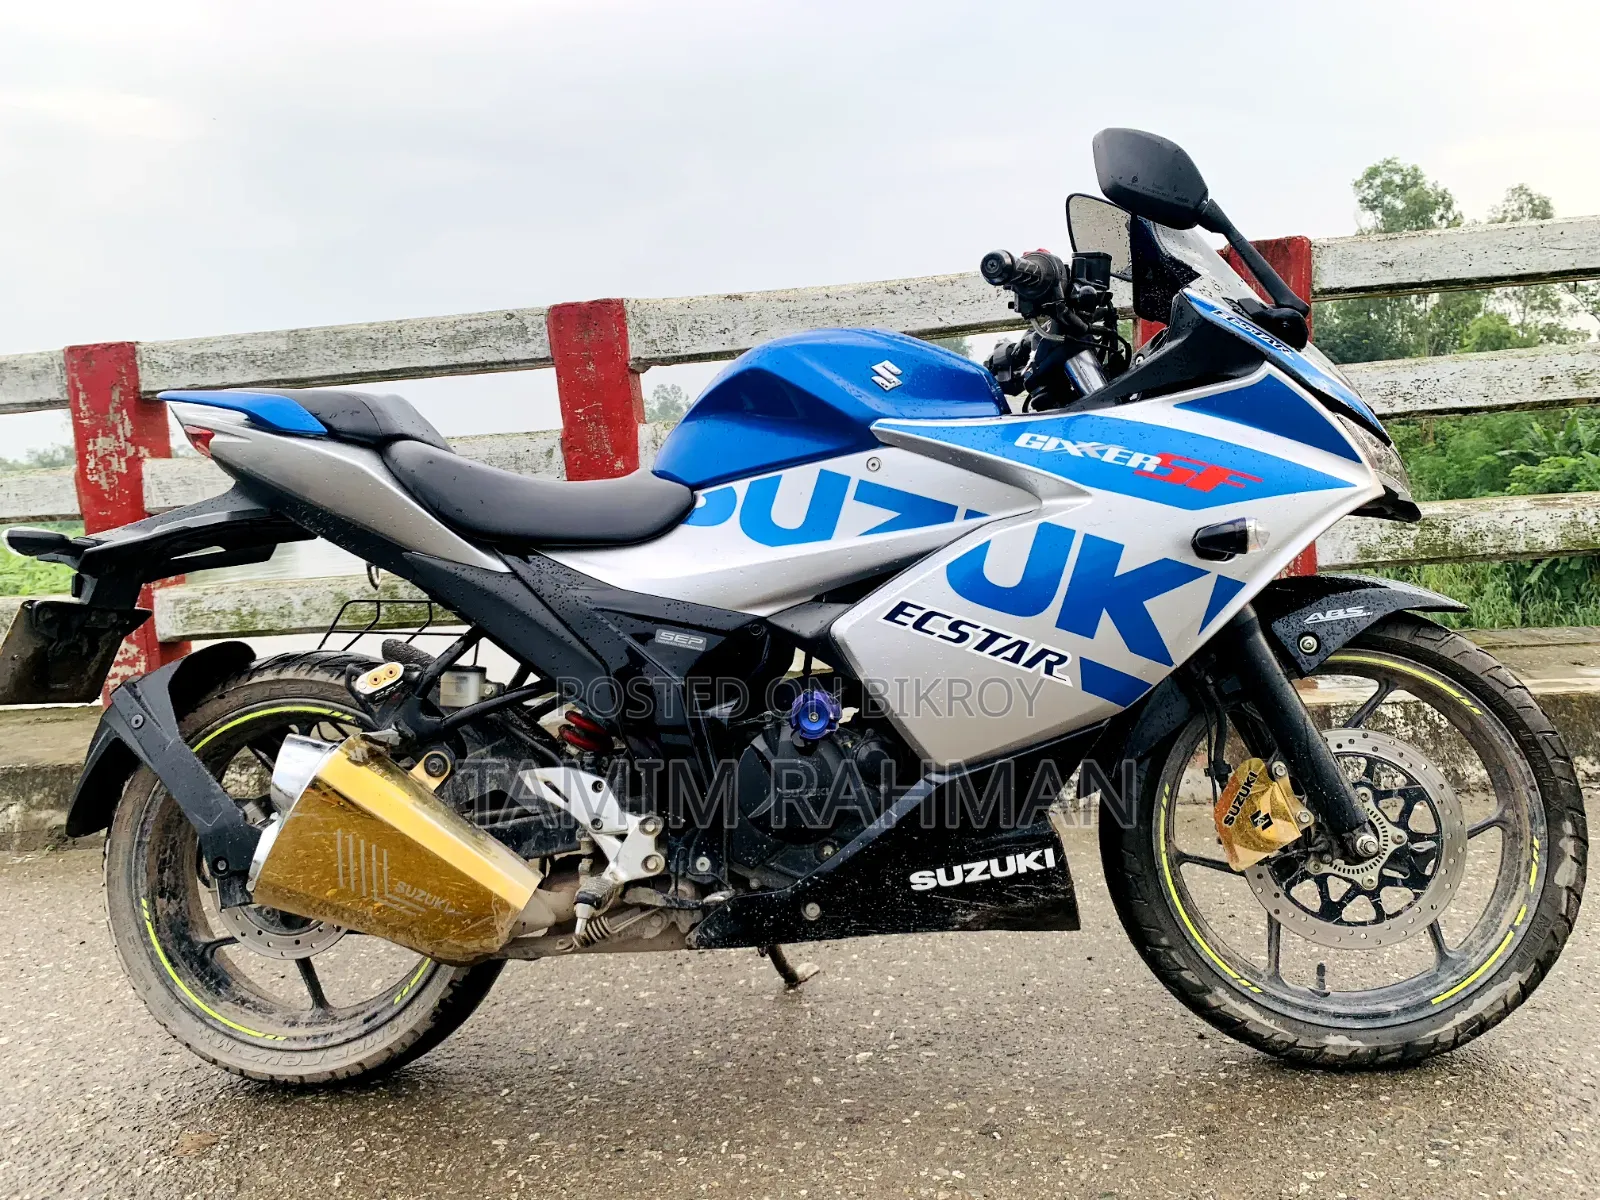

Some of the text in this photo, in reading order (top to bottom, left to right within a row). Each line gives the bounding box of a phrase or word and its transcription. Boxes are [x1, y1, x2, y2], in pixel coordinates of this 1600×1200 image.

[1013, 432, 1264, 493] GIXXER SF
[1303, 605, 1366, 625] ABS
[659, 631, 704, 645] SEP
[882, 600, 1068, 683] ECSTAR
[1222, 770, 1259, 827] SUZUKI
[908, 847, 1056, 892] SUZUKI
[394, 880, 456, 915] SUZUKI
